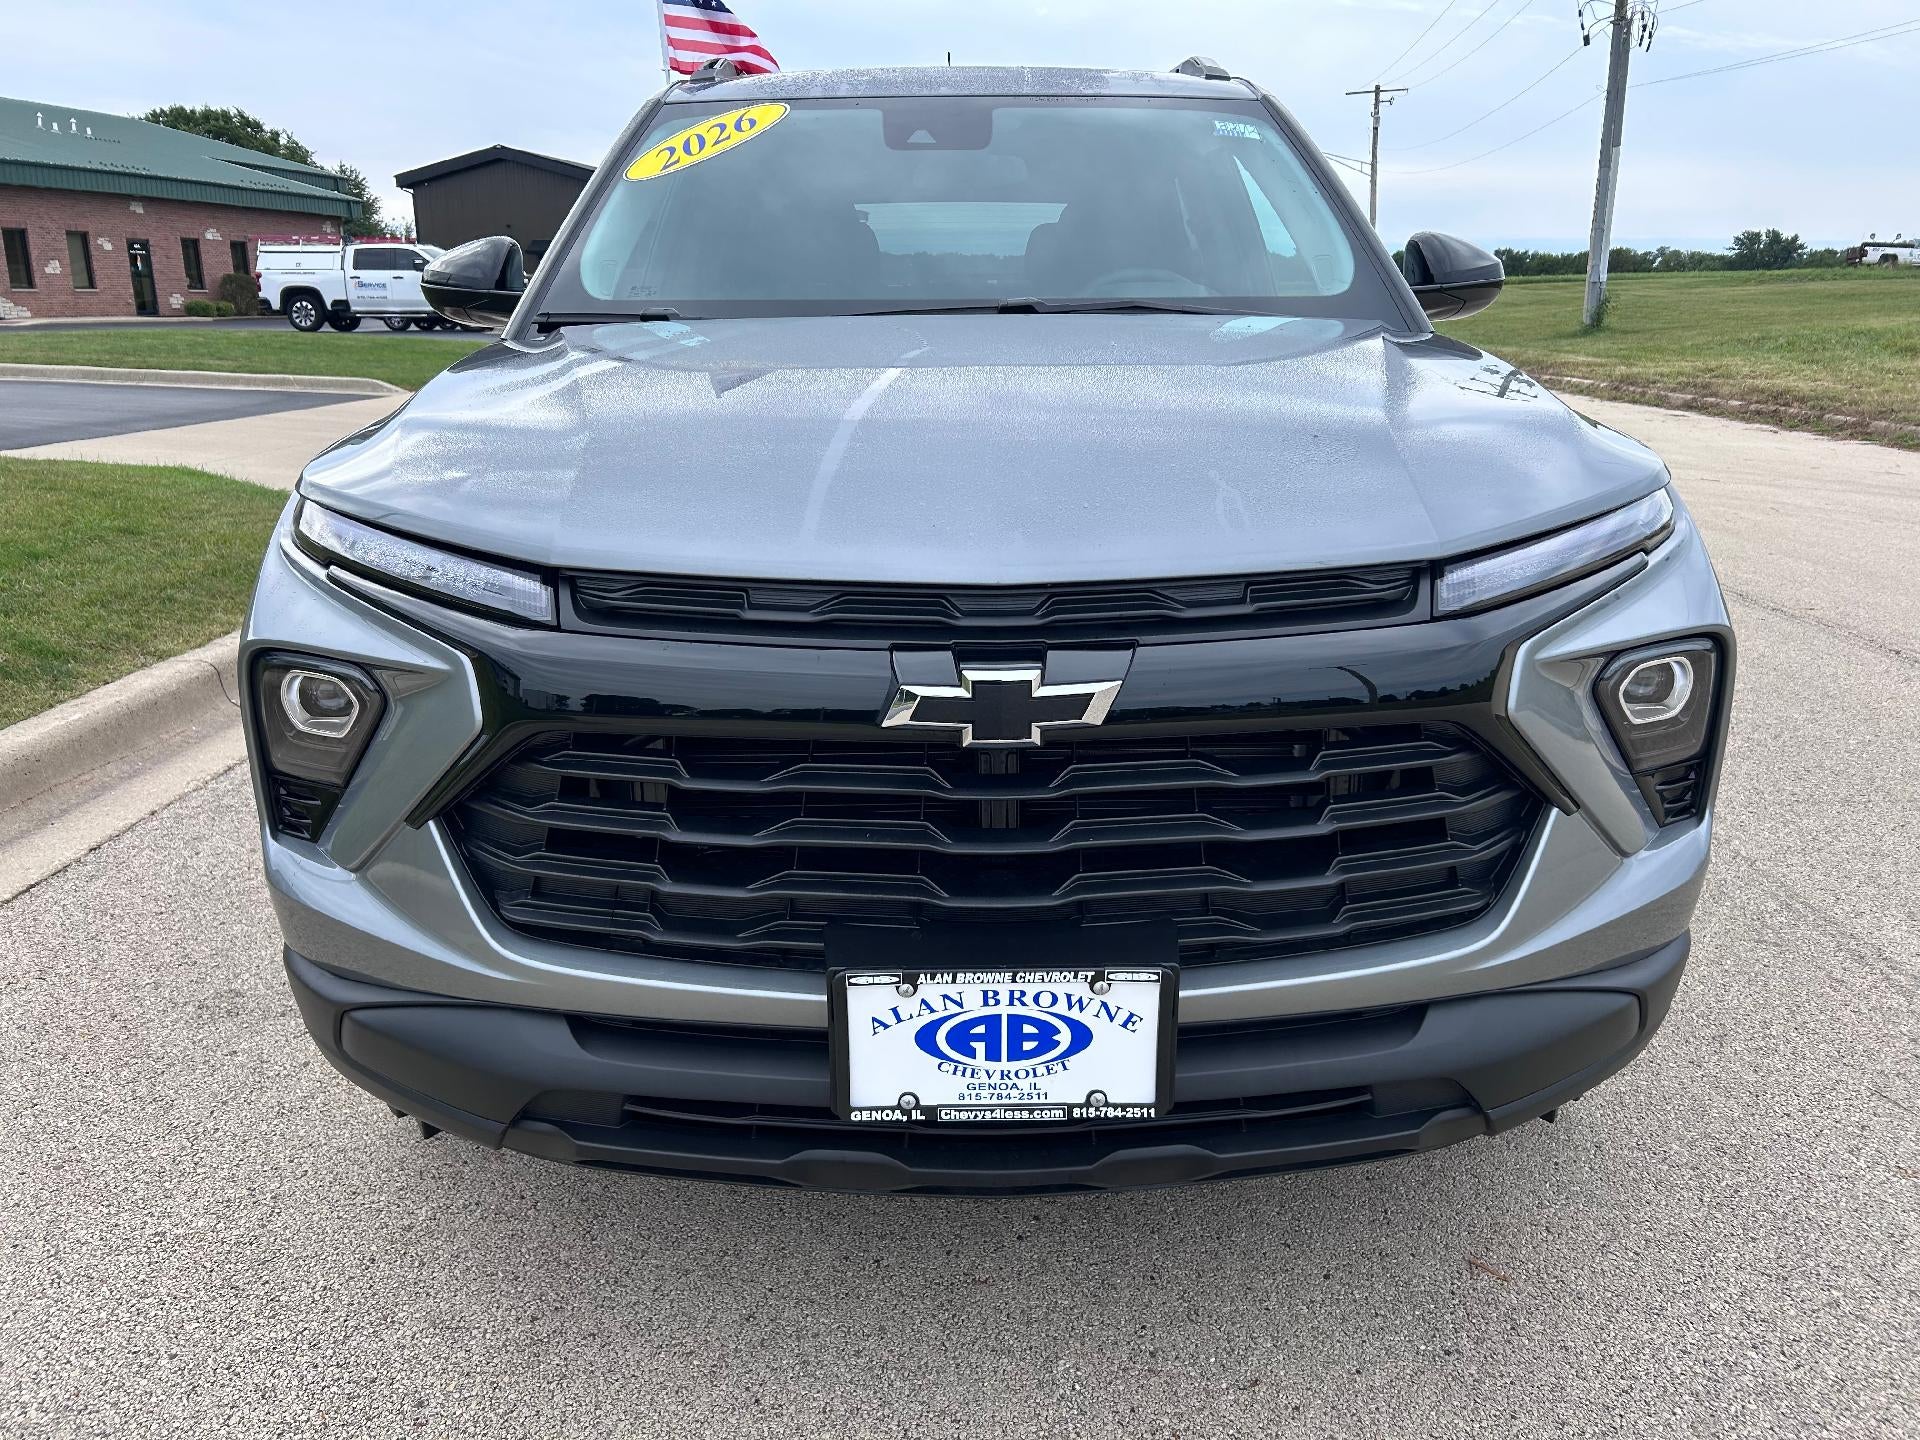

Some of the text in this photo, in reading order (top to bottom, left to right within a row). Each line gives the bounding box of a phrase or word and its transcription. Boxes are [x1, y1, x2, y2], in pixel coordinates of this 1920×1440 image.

[655, 110, 757, 172] 2026
[917, 972, 952, 985] ALAN
[955, 971, 1013, 984] BROWNE
[1015, 970, 1095, 983] CHEVROLET
[870, 989, 1144, 1037] ALAN BROWNE
[937, 1058, 1072, 1081] CHEVROLET
[966, 1081, 1042, 1093] GENOA, IL
[957, 1091, 1049, 1102] 815-784-2511
[850, 1108, 926, 1122] GENOA, IL
[940, 1108, 1064, 1122] Chevys4less.com
[1072, 1106, 1156, 1118] 815-784-2511
